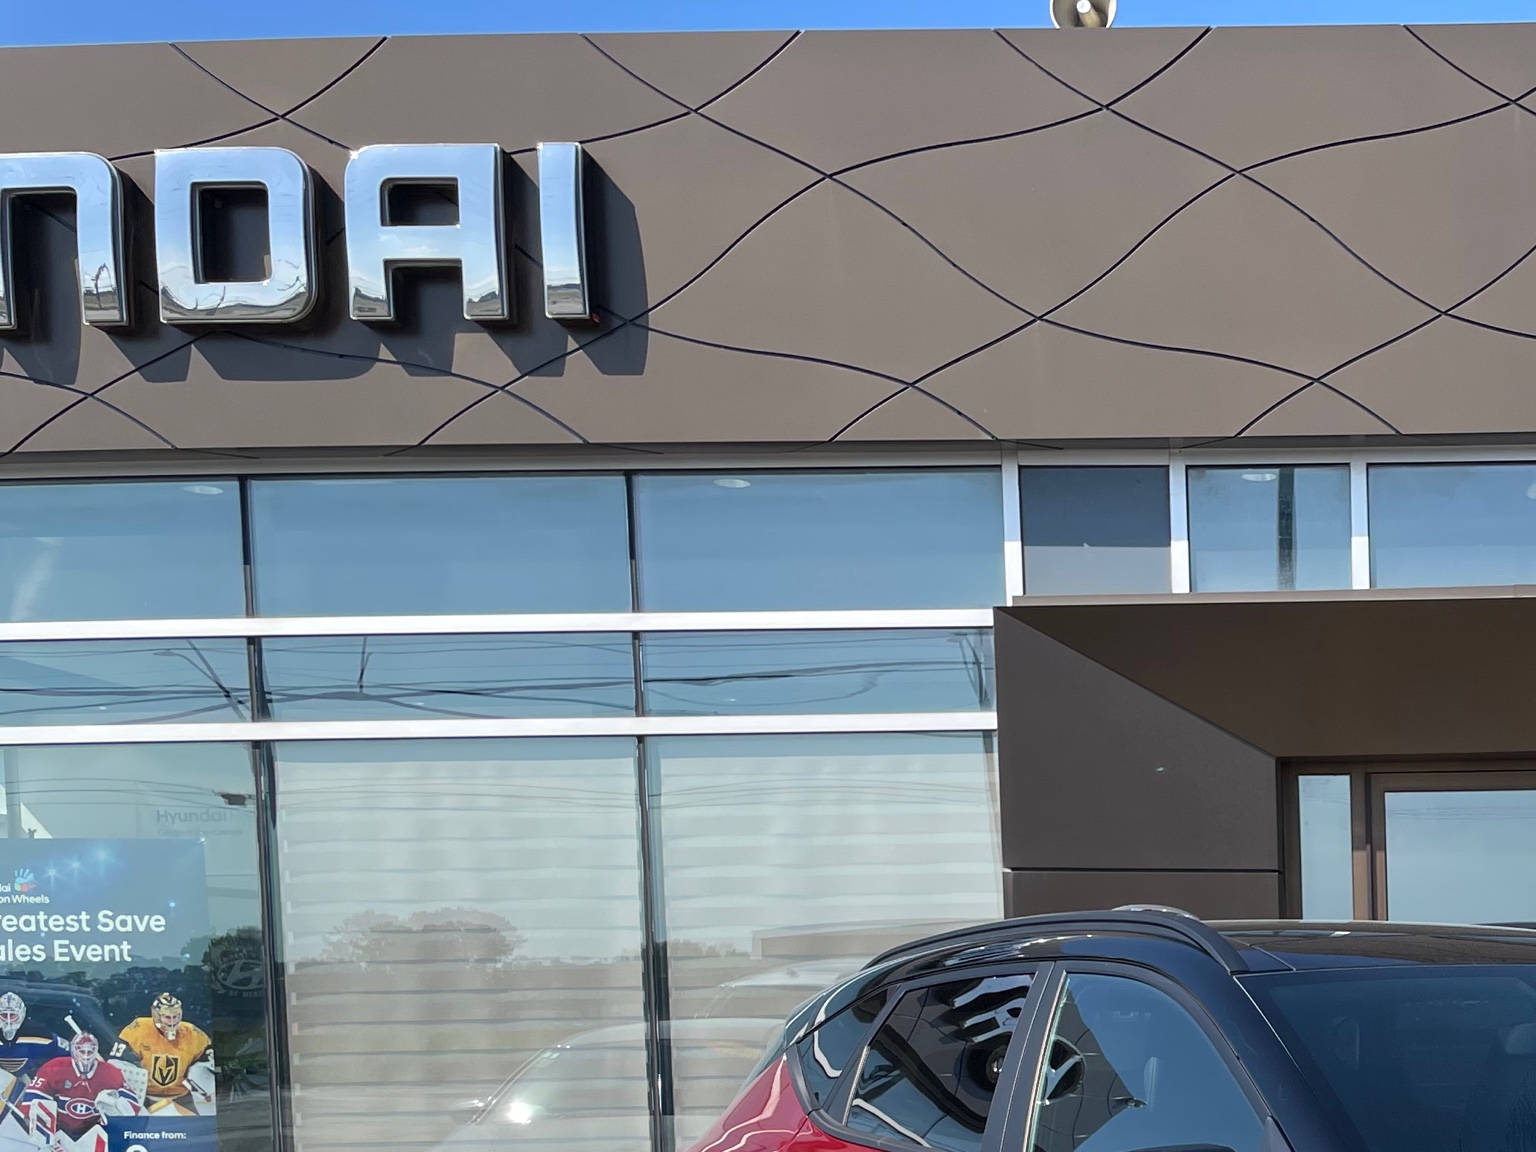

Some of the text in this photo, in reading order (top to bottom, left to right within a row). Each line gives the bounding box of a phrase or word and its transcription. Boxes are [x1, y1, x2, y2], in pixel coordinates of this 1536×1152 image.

[0, 883, 11, 893] ai
[11, 894, 50, 904] Wheels
[0, 910, 166, 932] eatest Save
[53, 939, 132, 962] Event
[123, 1131, 187, 1140] Finance from:
